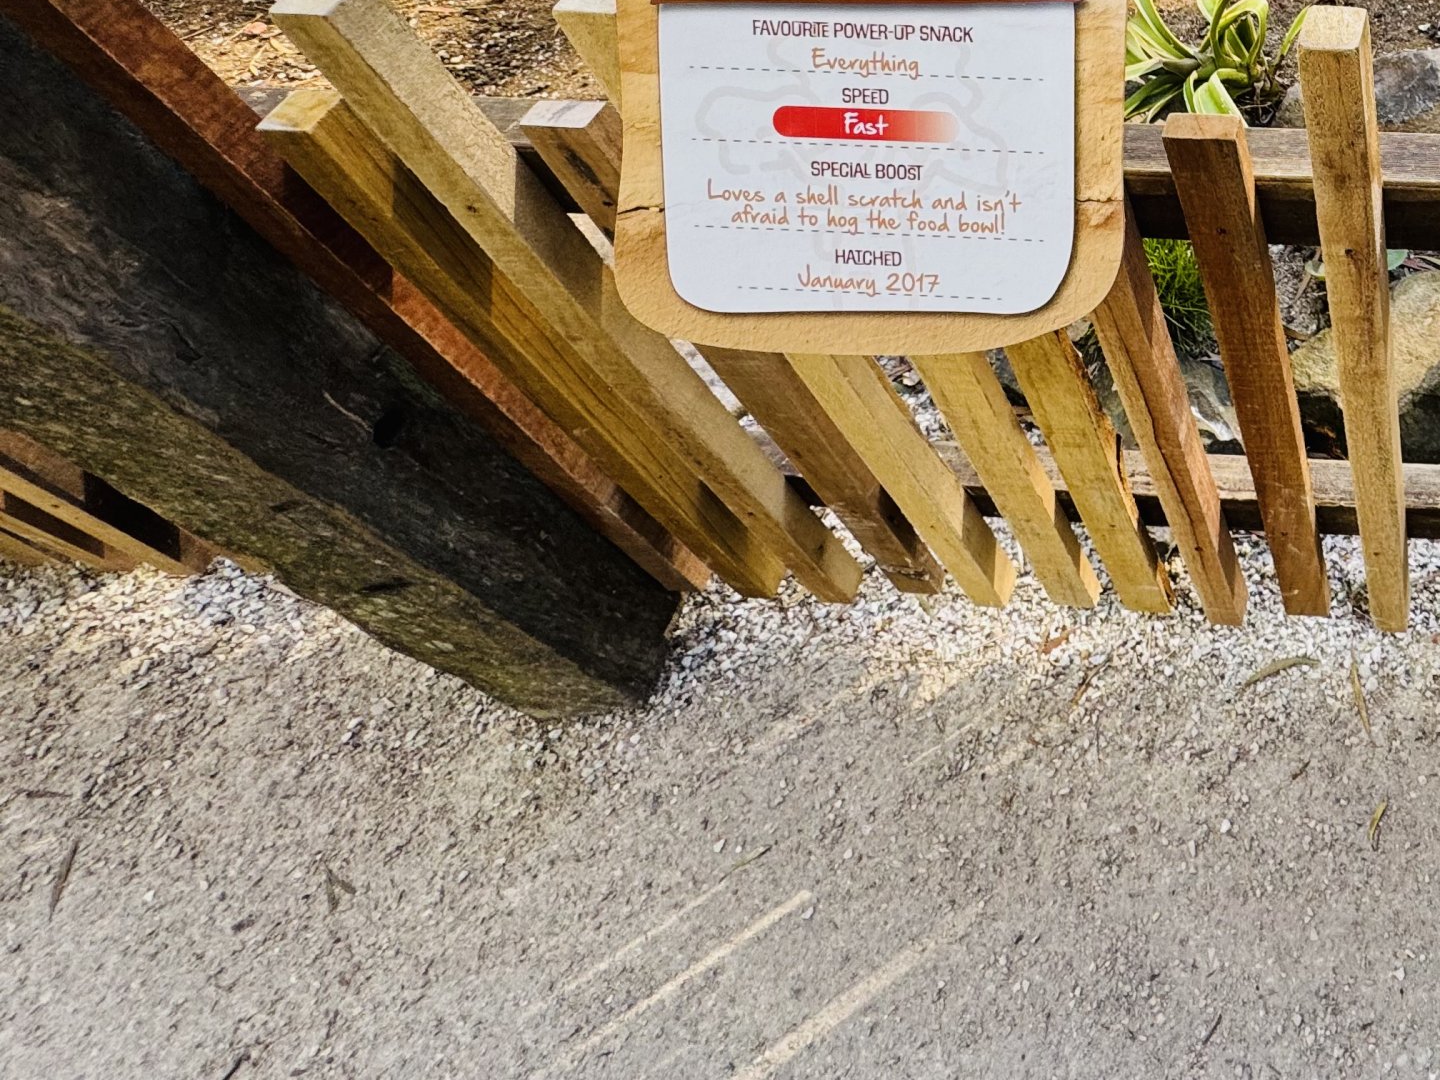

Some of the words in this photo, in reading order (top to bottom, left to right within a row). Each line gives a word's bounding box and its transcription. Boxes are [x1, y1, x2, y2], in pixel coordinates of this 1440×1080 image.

[833, 23, 916, 40] POWER-UP
[919, 26, 973, 43] SNACK
[811, 48, 919, 79] Everything
[842, 88, 889, 104] SPEED
[844, 112, 889, 136] Fast
[875, 164, 924, 181] BOOST
[708, 178, 766, 203] Loves
[774, 191, 788, 204] a
[796, 186, 839, 205] shell
[848, 189, 923, 209] scratch
[932, 191, 967, 211] and
[976, 191, 1023, 212] isn't
[731, 204, 789, 225] afraid
[800, 209, 818, 226] to
[827, 211, 859, 235] hog
[866, 211, 901, 229] the
[907, 213, 949, 232] food
[958, 213, 1006, 235] bowl!
[834, 249, 902, 267] HATCHED
[797, 265, 877, 296] January
[886, 273, 940, 293] 2017
